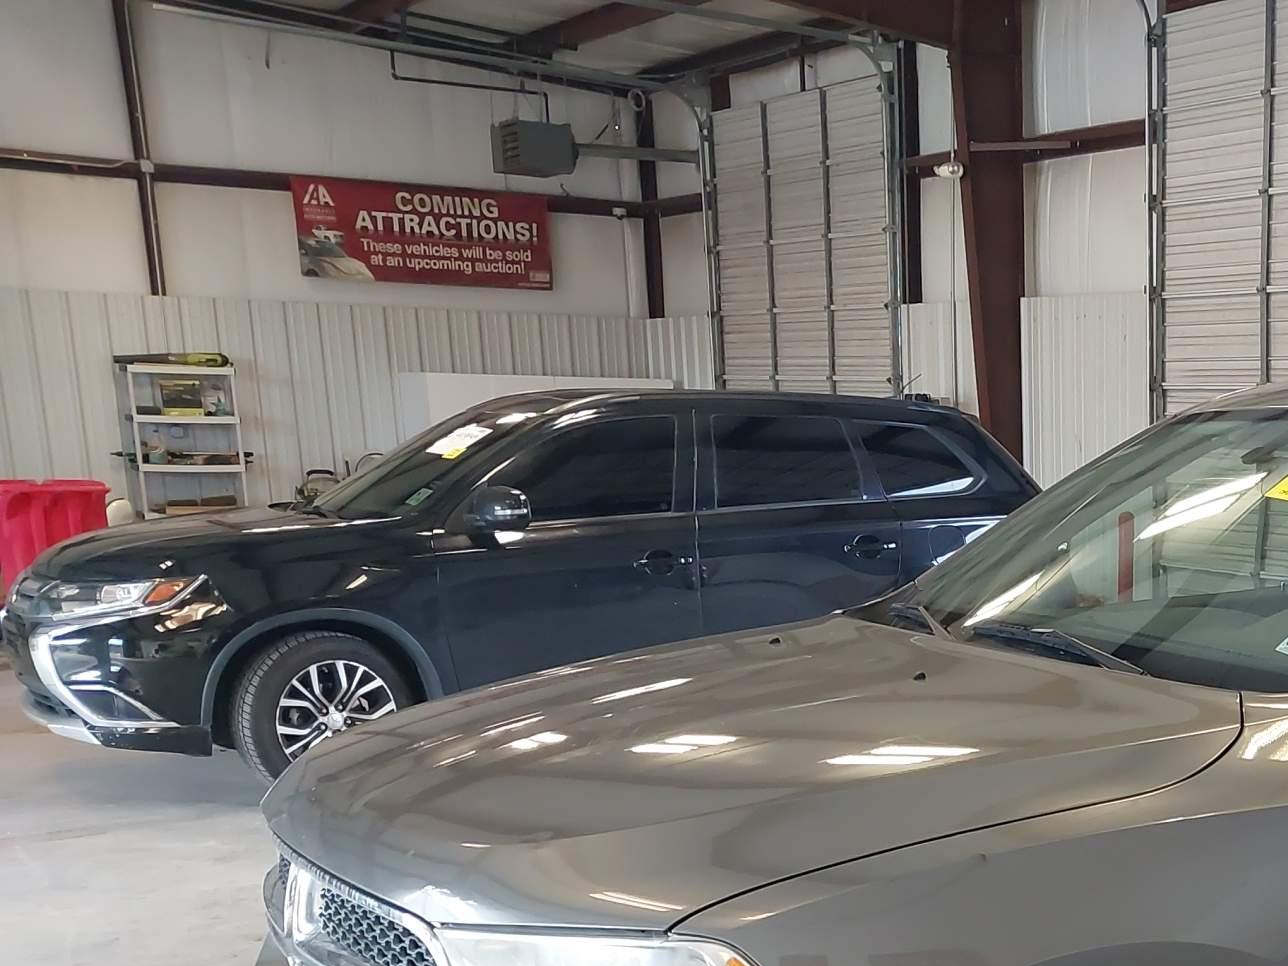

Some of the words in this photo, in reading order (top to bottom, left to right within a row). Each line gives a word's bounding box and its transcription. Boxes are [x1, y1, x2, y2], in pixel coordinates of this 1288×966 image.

[395, 191, 499, 218] COMING
[355, 210, 538, 241] ATTRACTIONS!
[360, 238, 402, 254] These
[405, 243, 459, 258] vehicles
[462, 247, 484, 260] will
[486, 248, 502, 260] be
[505, 250, 532, 262] sold
[370, 253, 384, 266] at
[386, 257, 403, 267] an
[406, 258, 473, 274] upcoming
[475, 261, 526, 275] auction!
